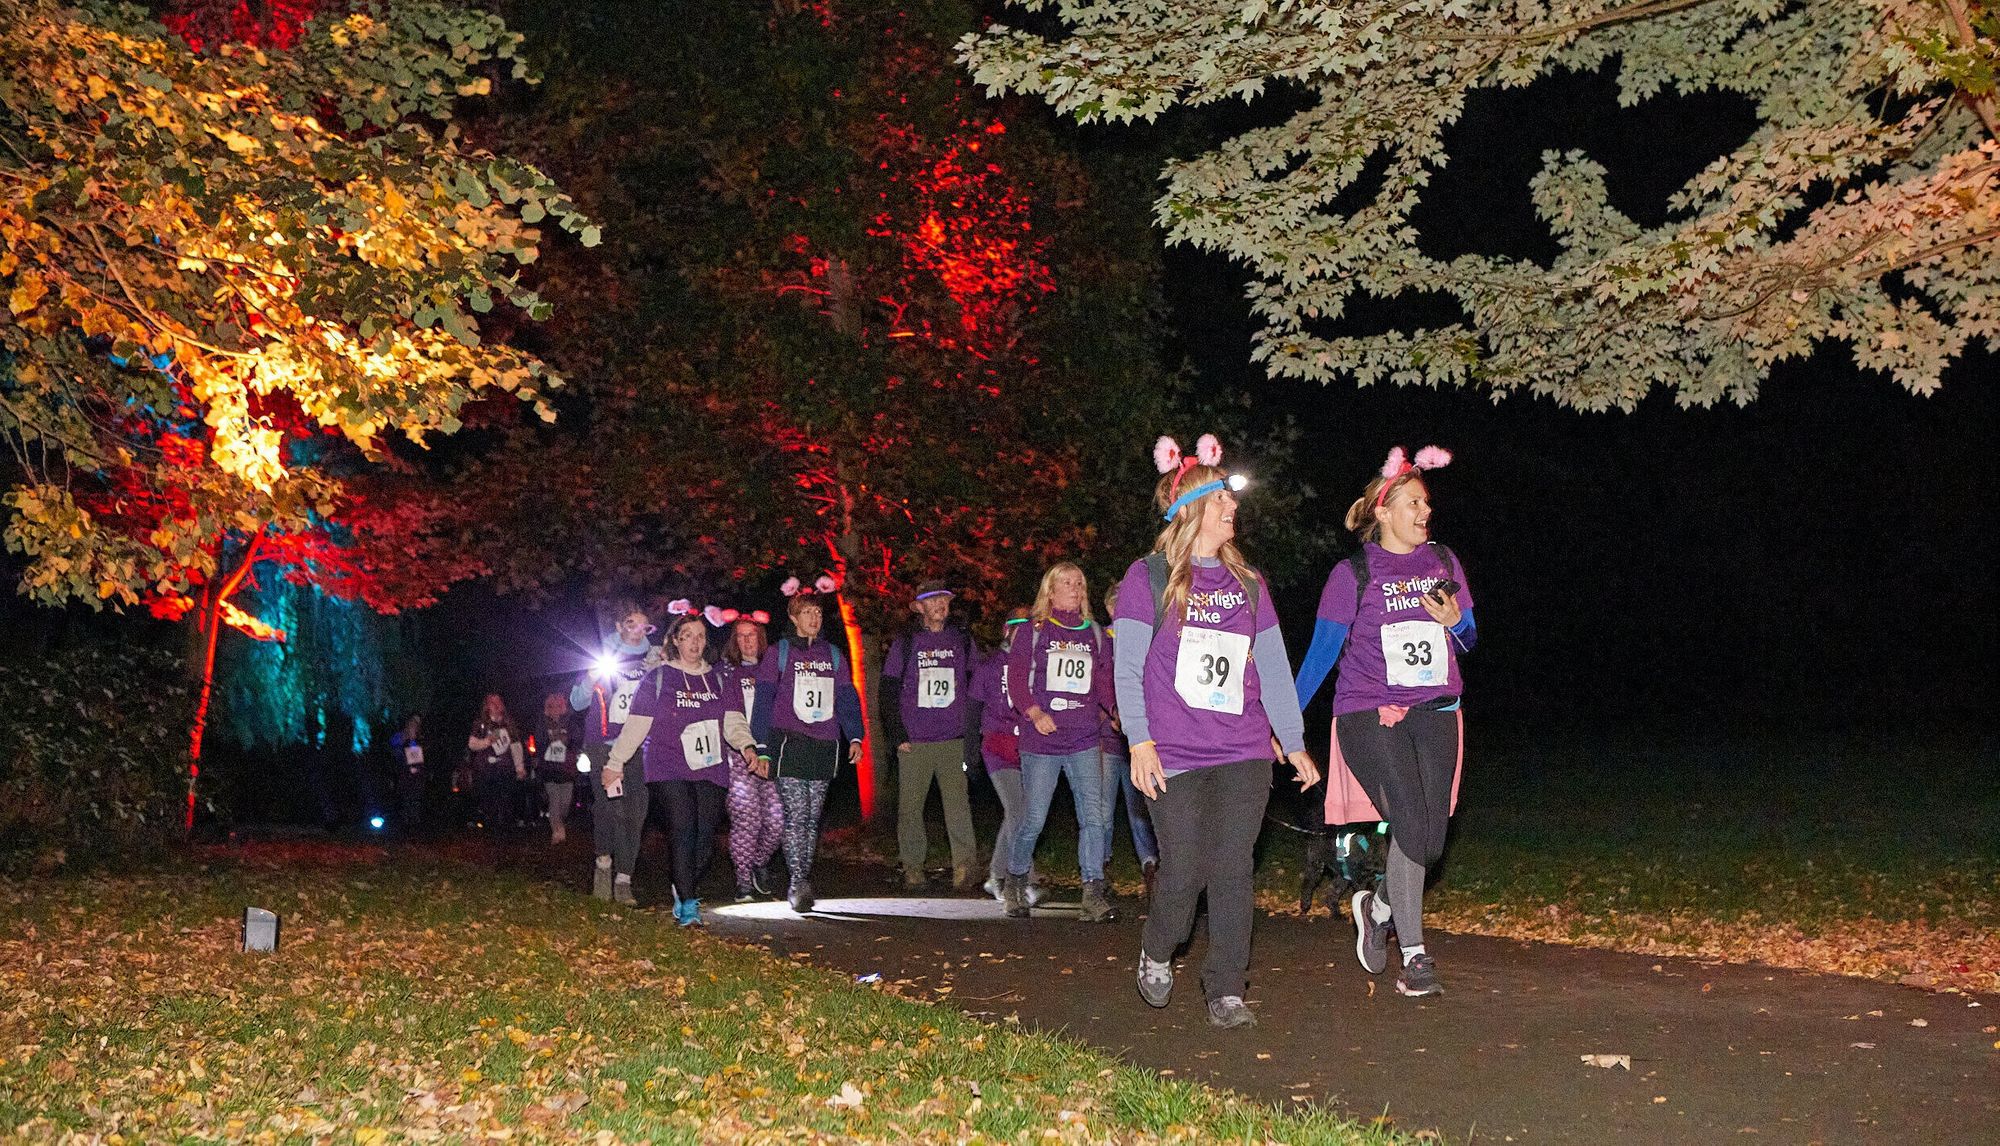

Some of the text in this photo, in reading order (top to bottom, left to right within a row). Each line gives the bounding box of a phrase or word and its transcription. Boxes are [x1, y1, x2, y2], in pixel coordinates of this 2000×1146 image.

[1382, 576, 1443, 597] Strligh
[1386, 596, 1420, 613] Hike
[1186, 606, 1221, 624] Hike
[1403, 640, 1433, 666] 33
[918, 659, 939, 668] Hike
[1057, 658, 1085, 679] 108
[1197, 654, 1230, 688] 39
[927, 680, 949, 696] 129
[618, 693, 635, 710] 3
[677, 699, 701, 708] Hike
[805, 690, 822, 708] 31
[695, 735, 711, 755] 41
